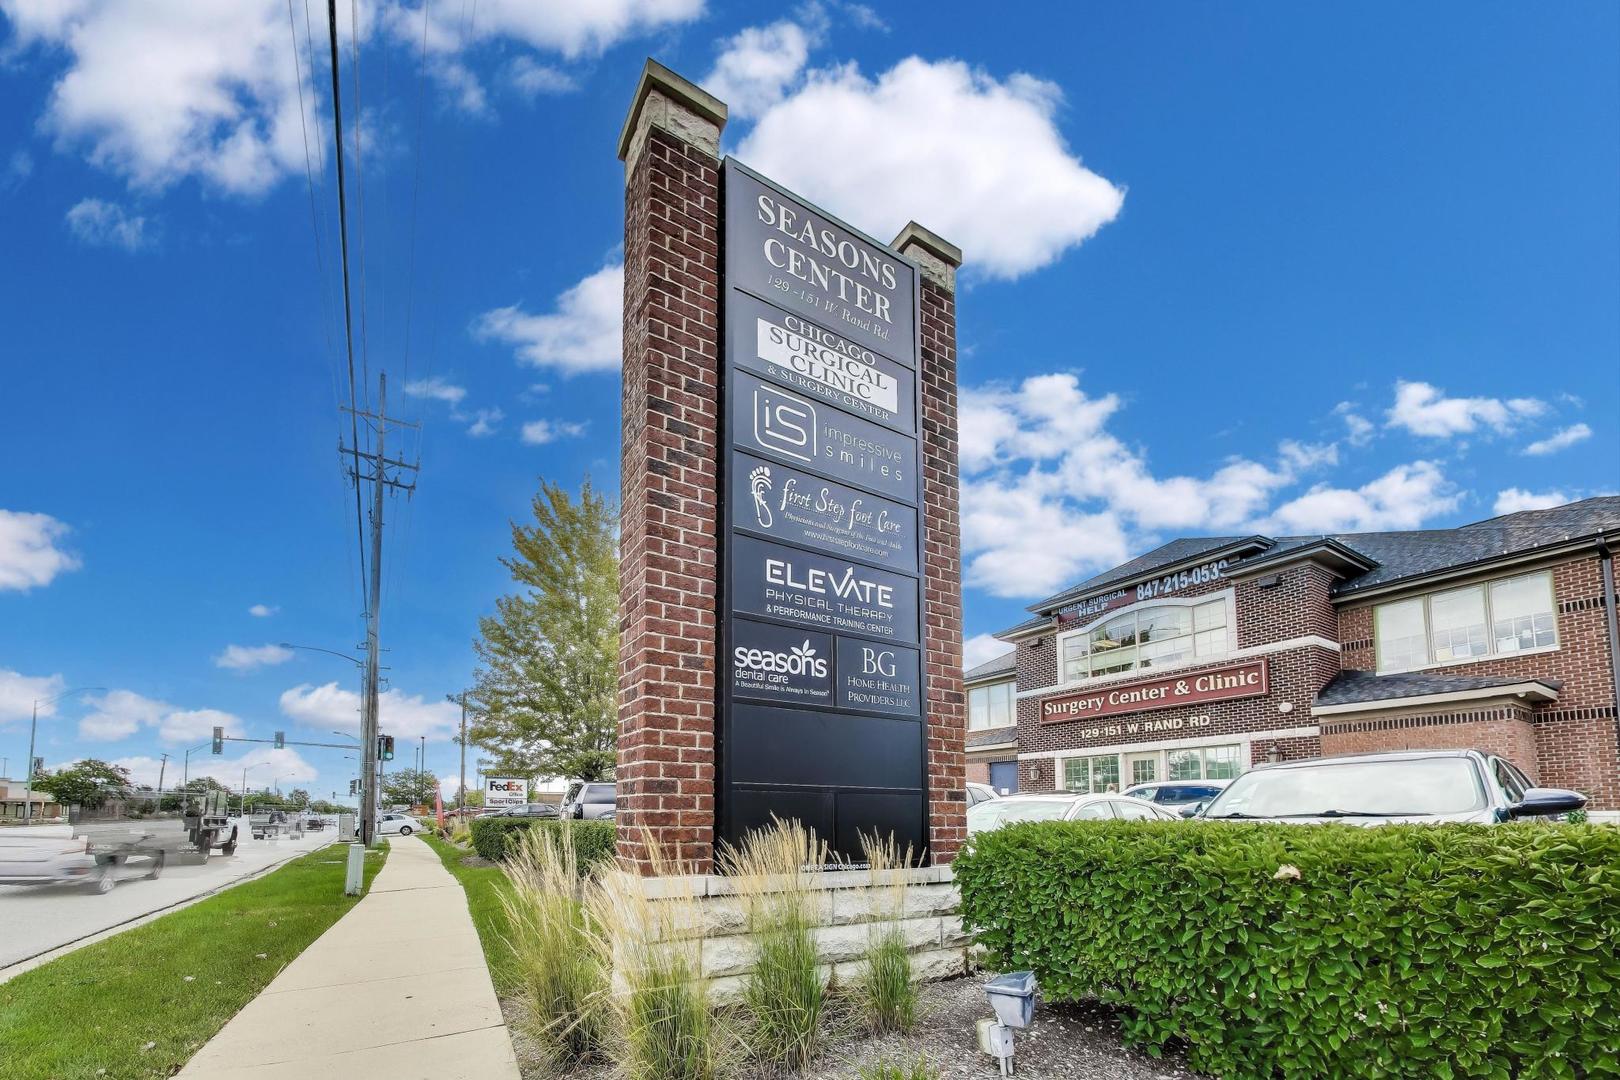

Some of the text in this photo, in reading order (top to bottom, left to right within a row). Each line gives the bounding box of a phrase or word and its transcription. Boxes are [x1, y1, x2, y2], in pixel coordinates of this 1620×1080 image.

[758, 195, 896, 290] SEASONS
[764, 238, 893, 324] CENTER
[768, 275, 819, 307] 129-151
[842, 308, 870, 331] Rand
[770, 326, 887, 390] SURGICAL
[785, 316, 876, 367] CHICAGO
[768, 365, 890, 421] & SURGERY CENTER
[790, 355, 872, 400] CLINIC
[824, 423, 902, 463] impressive
[816, 488, 845, 523] Step
[878, 510, 901, 533] Care
[766, 558, 893, 608] ELEVATE
[1058, 589, 1127, 615] URGENT SURGICAL
[766, 588, 893, 623] PHYSICAL THERAPY
[766, 604, 893, 635] & PERFORMANCE TRAINING CENTER
[1078, 603, 1108, 618] HELP
[734, 646, 828, 678] seasons
[735, 668, 789, 684] dental care
[862, 647, 896, 677] BG
[740, 681, 764, 690] Beautiful
[765, 683, 779, 692] Smile
[786, 686, 803, 695] Always
[1044, 671, 1259, 715] Surgery Center & Clinic
[1081, 714, 1211, 739] 129-151 W RAND RD
[489, 780, 523, 791] FedEx
